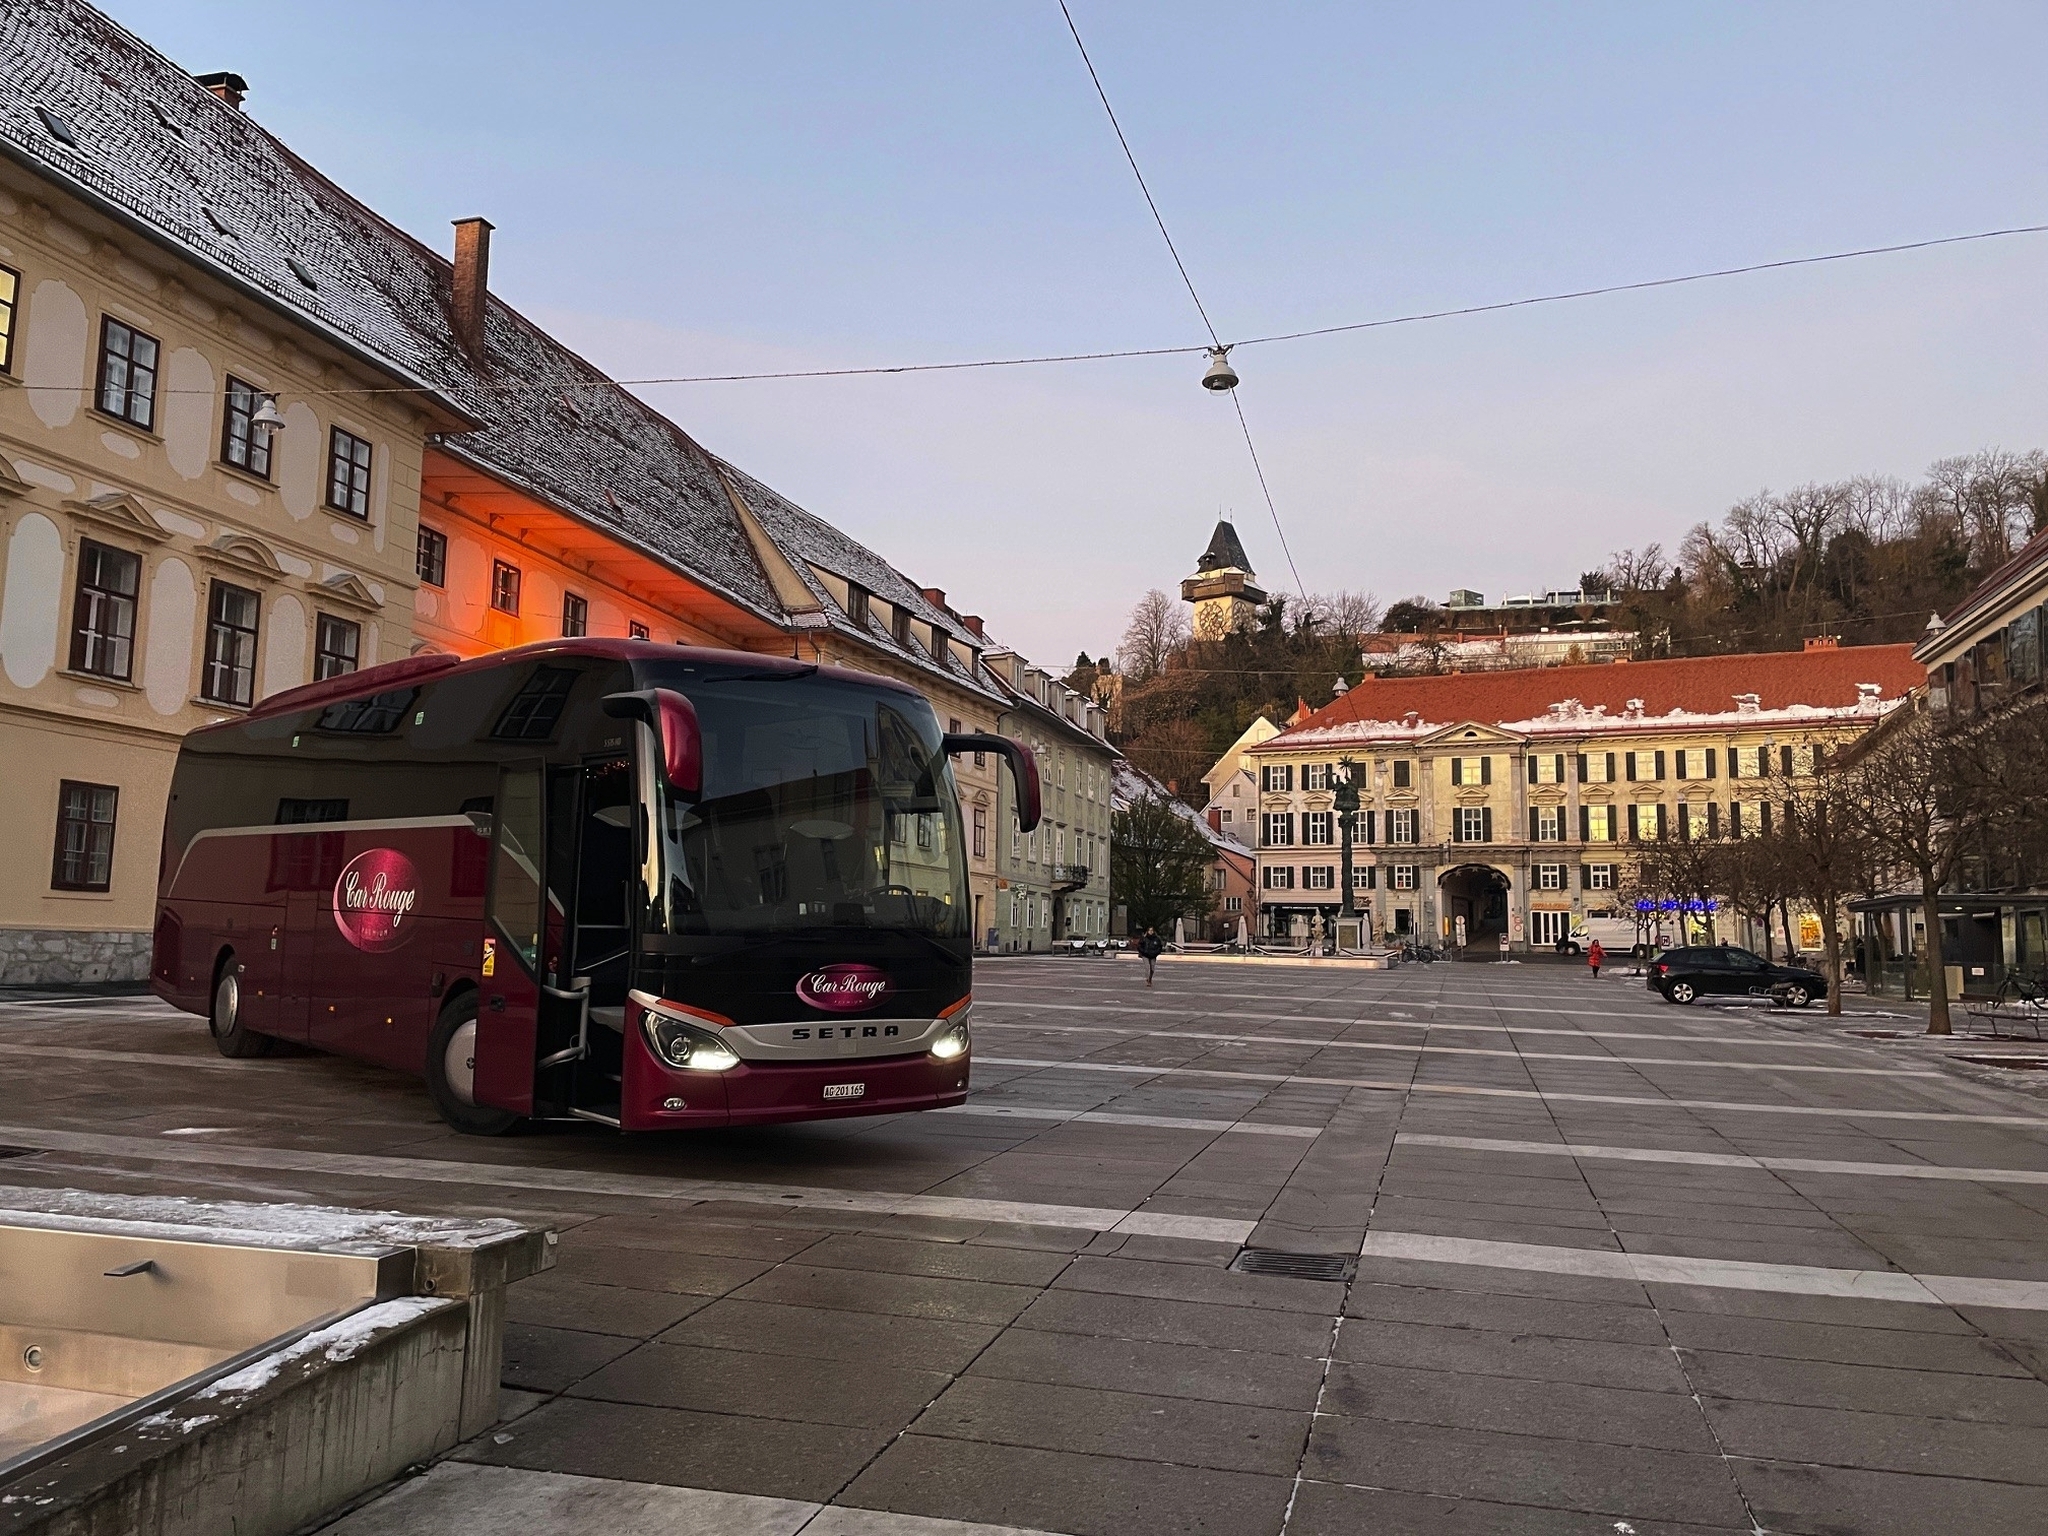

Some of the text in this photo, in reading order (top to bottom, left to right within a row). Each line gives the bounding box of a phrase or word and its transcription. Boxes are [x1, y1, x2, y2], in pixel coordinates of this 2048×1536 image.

[345, 871, 415, 928] Car Rouge
[811, 973, 886, 1000] Car Rouge
[792, 1025, 899, 1040] SETRA
[824, 1084, 864, 1097] AG 201 165
